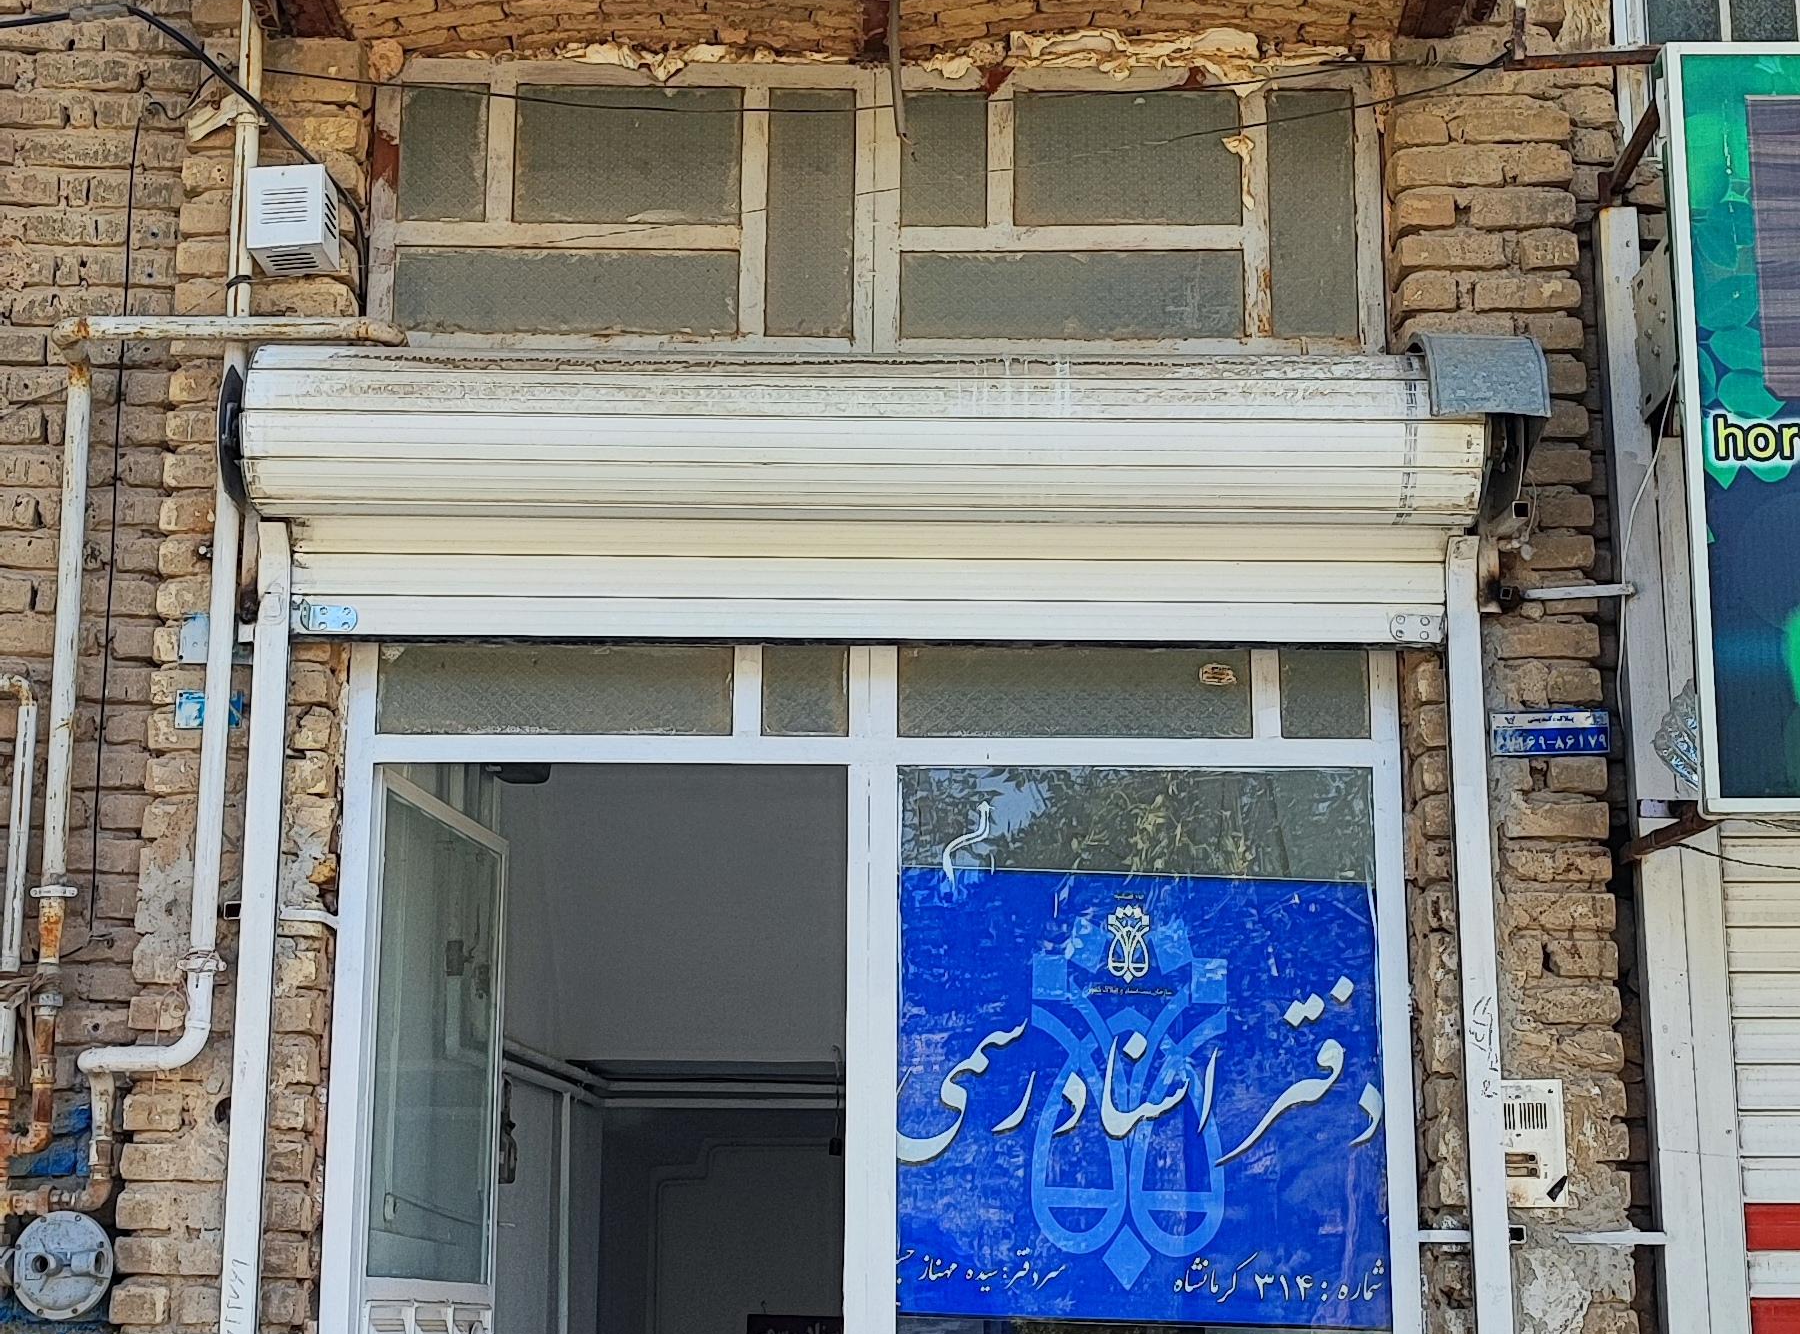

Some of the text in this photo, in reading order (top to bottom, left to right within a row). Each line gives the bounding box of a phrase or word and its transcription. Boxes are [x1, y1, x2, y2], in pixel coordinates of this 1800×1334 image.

[896, 1017, 1033, 1164] رسمی
[1054, 1031, 1219, 1139] اسناد
[1216, 975, 1384, 1166] دفتر
[918, 1254, 959, 1281] مهناز
[965, 1268, 998, 1292] سیده
[1173, 1250, 1259, 1304] کرمانشاه
[1253, 1273, 1314, 1302] ۳۱۴
